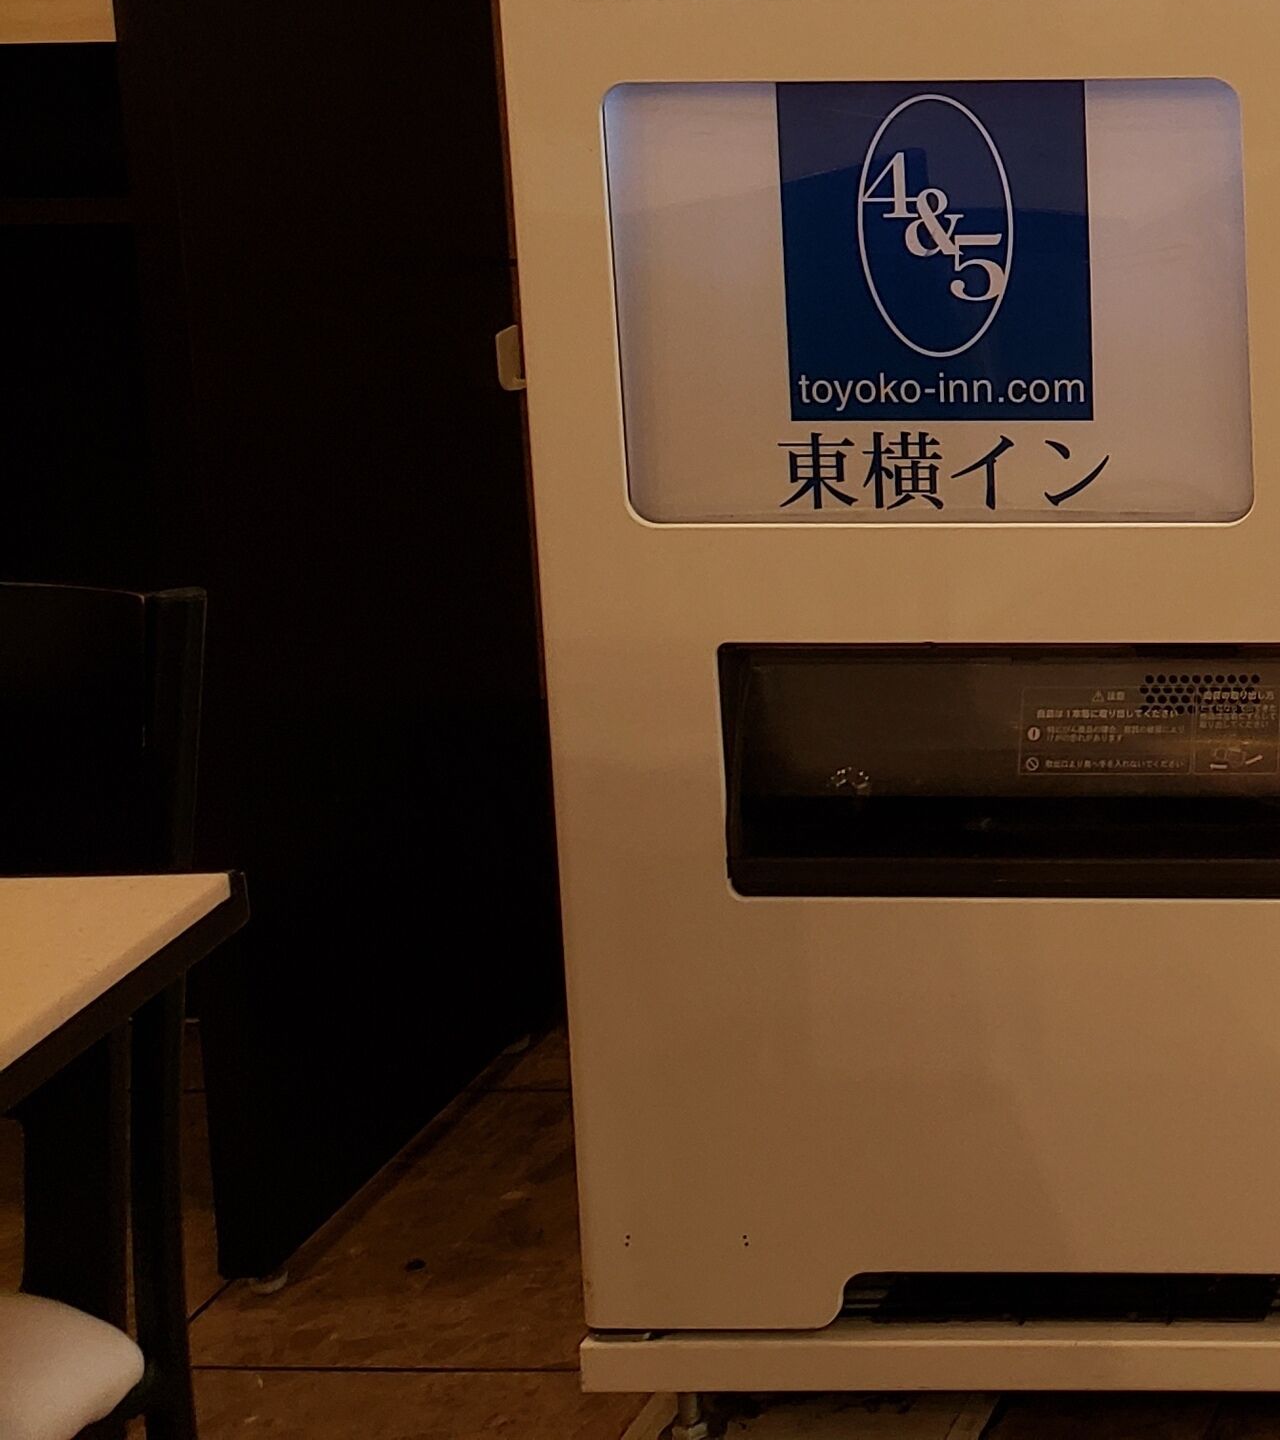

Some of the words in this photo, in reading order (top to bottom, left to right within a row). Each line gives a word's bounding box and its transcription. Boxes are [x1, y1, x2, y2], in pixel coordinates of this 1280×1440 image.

[862, 151, 1006, 301] 4&5
[799, 373, 1086, 411] toyoko-inn.com
[777, 431, 1110, 510] 東横イン
